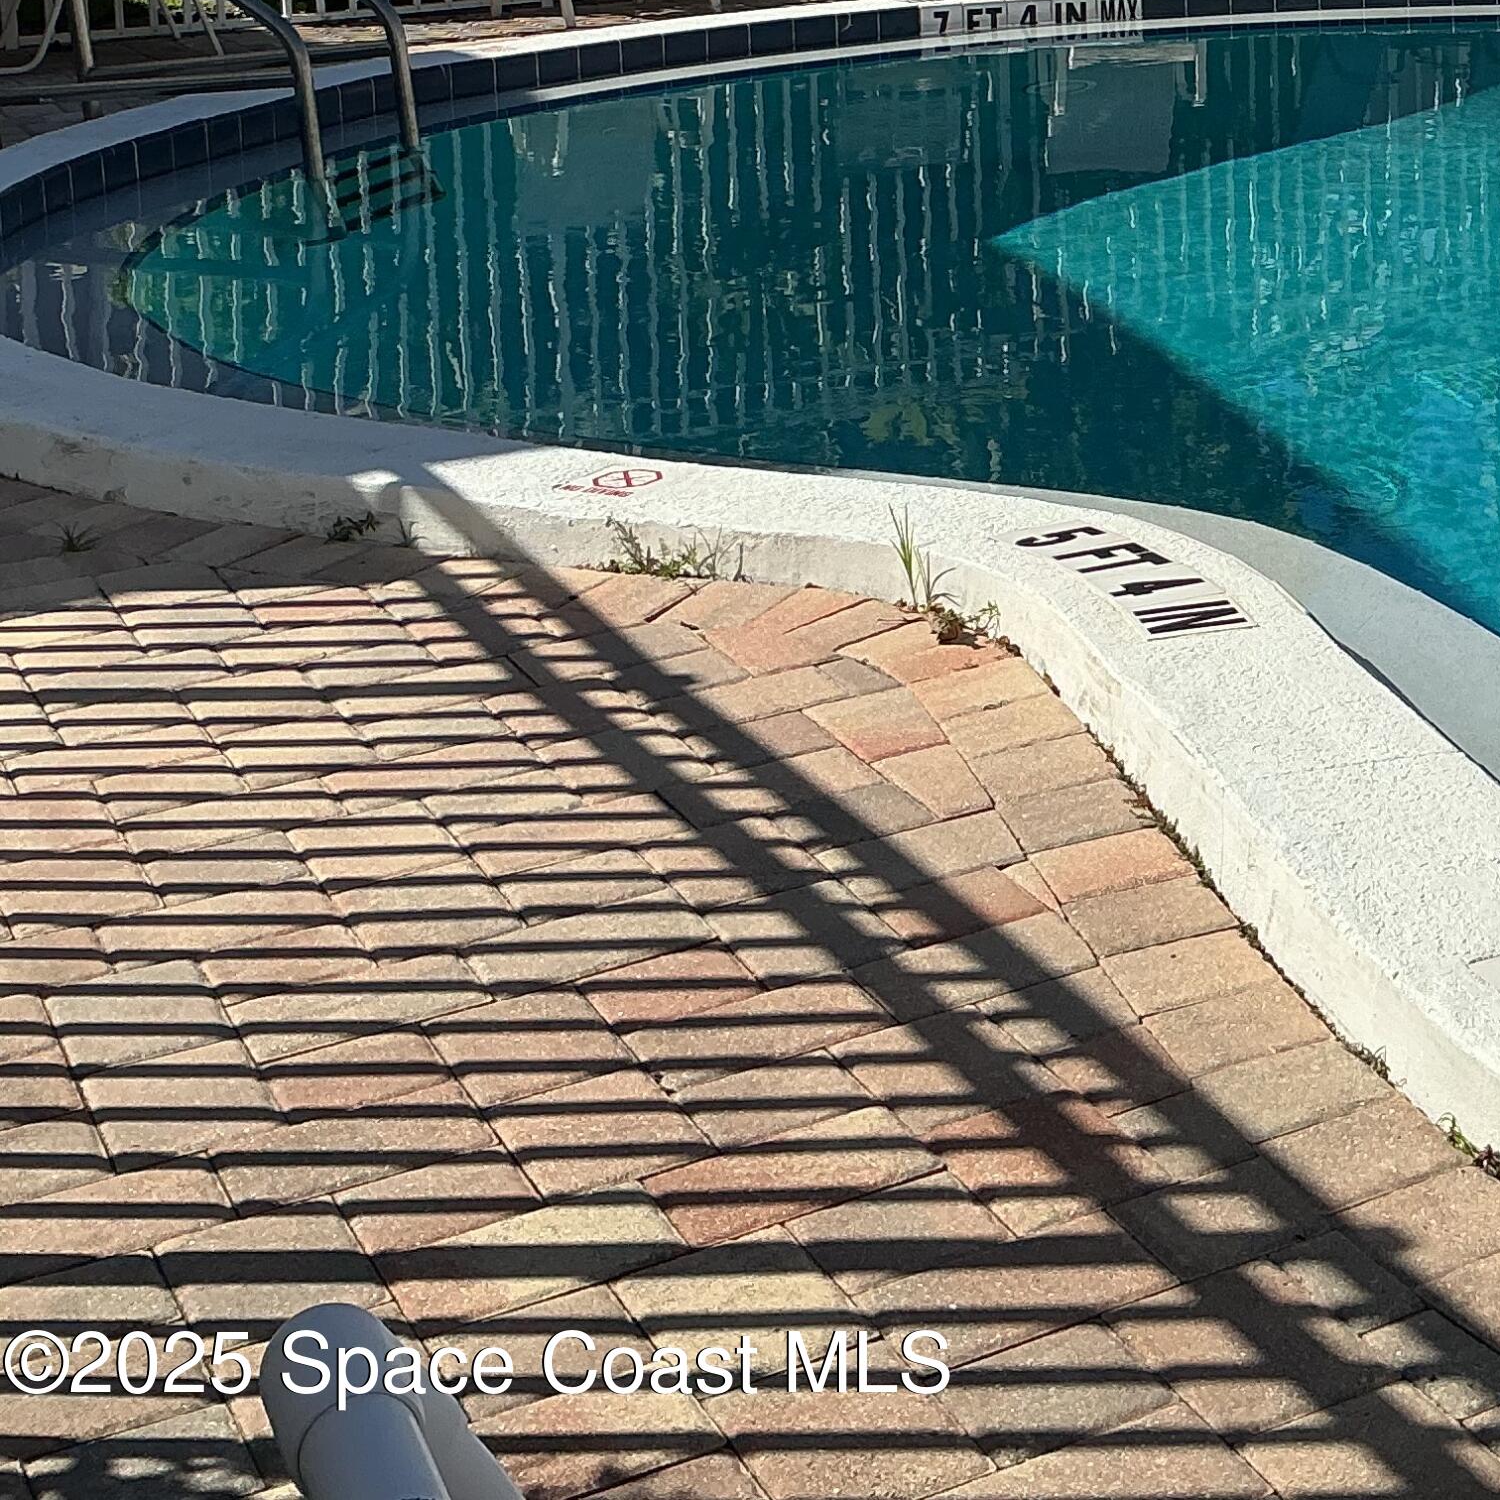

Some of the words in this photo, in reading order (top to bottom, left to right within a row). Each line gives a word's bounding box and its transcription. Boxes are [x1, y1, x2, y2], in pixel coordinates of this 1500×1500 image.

[933, 11, 949, 33] 7
[967, 7, 1003, 31] FT
[1020, 5, 1038, 25] 4
[1055, 2, 1087, 23] IN
[582, 487, 634, 497] DIVING
[1016, 526, 1106, 547] 5
[1053, 543, 1173, 573] FT
[1109, 578, 1205, 597] 4
[1133, 600, 1248, 634] IN
